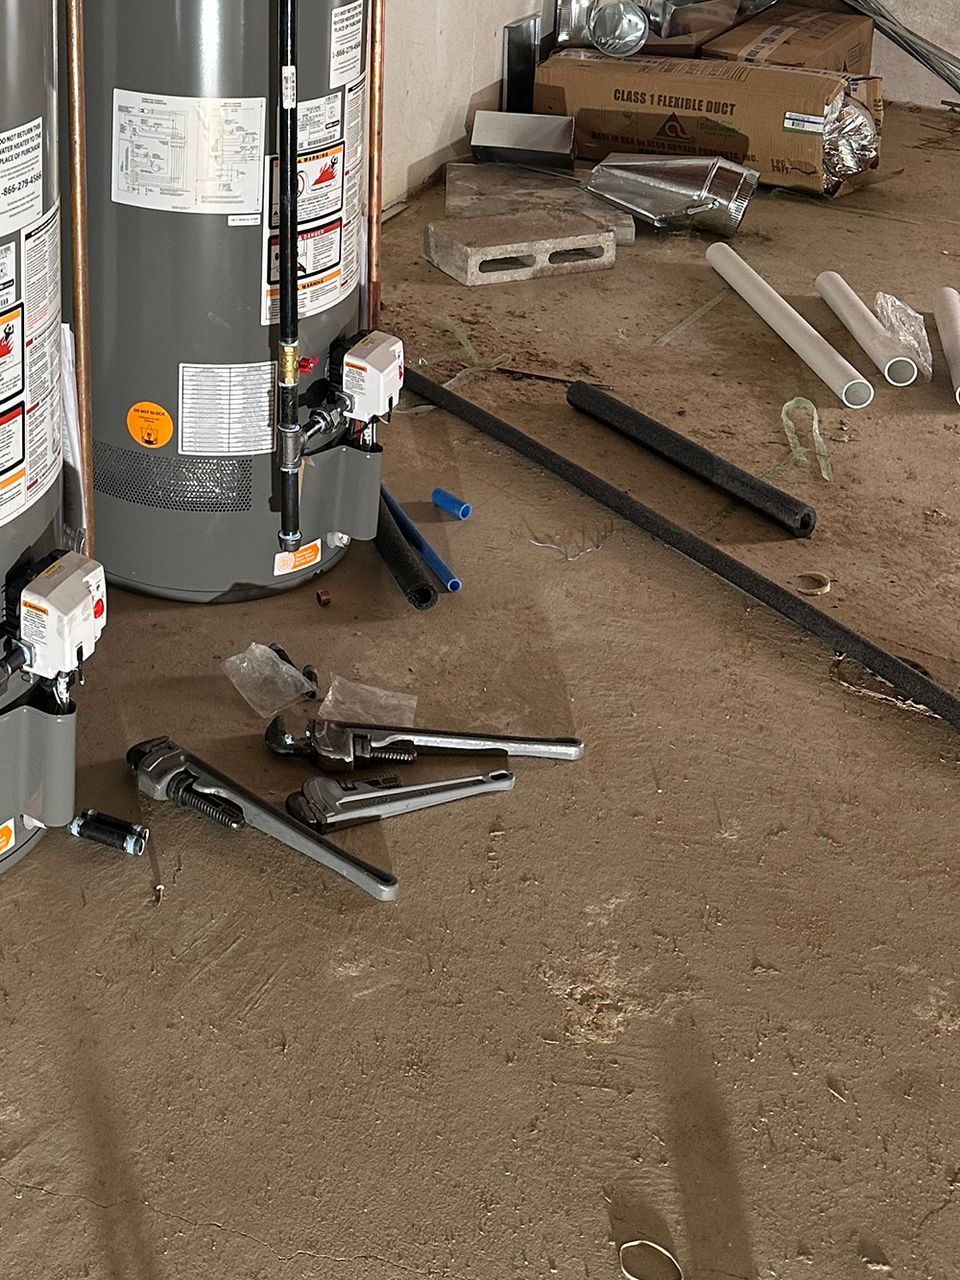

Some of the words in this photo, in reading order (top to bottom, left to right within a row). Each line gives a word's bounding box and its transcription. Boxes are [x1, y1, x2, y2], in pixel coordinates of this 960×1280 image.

[614, 88, 646, 105] CLASS
[650, 93, 655, 105] 1
[657, 94, 703, 111] FLEXIBLE
[706, 101, 736, 116] DUCT
[7, 133, 16, 142] NOT
[17, 127, 33, 139] RETURN
[14, 138, 30, 150] HEATER
[30, 135, 36, 143] TO
[14, 151, 21, 160] OF
[21, 142, 41, 157] PURCHASE
